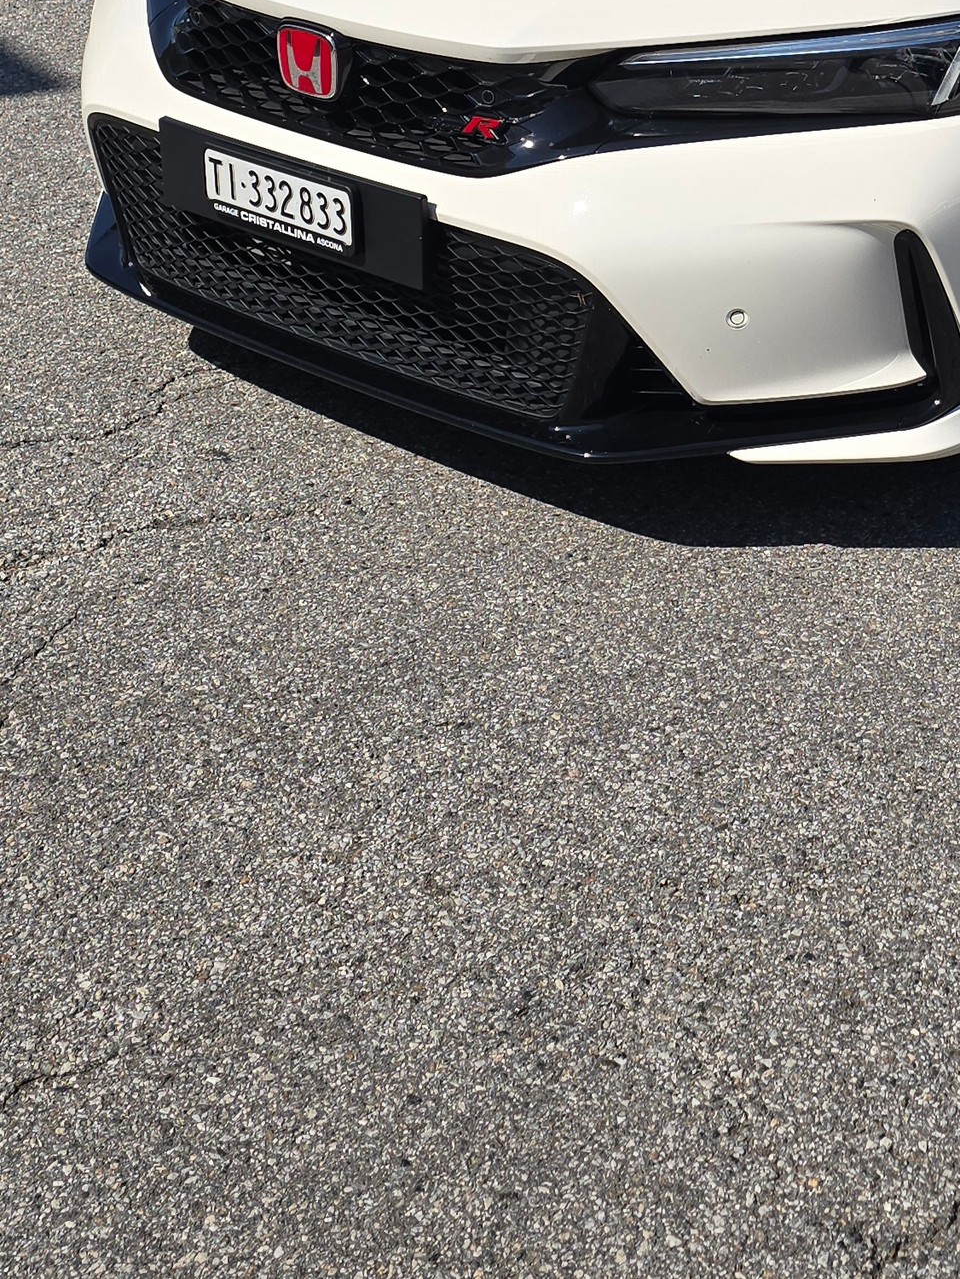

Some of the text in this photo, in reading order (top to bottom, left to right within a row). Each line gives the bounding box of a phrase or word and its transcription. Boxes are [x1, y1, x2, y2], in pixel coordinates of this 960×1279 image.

[462, 116, 505, 140] R
[213, 202, 344, 253] GARAGE CRISTALLINA ASCONA
